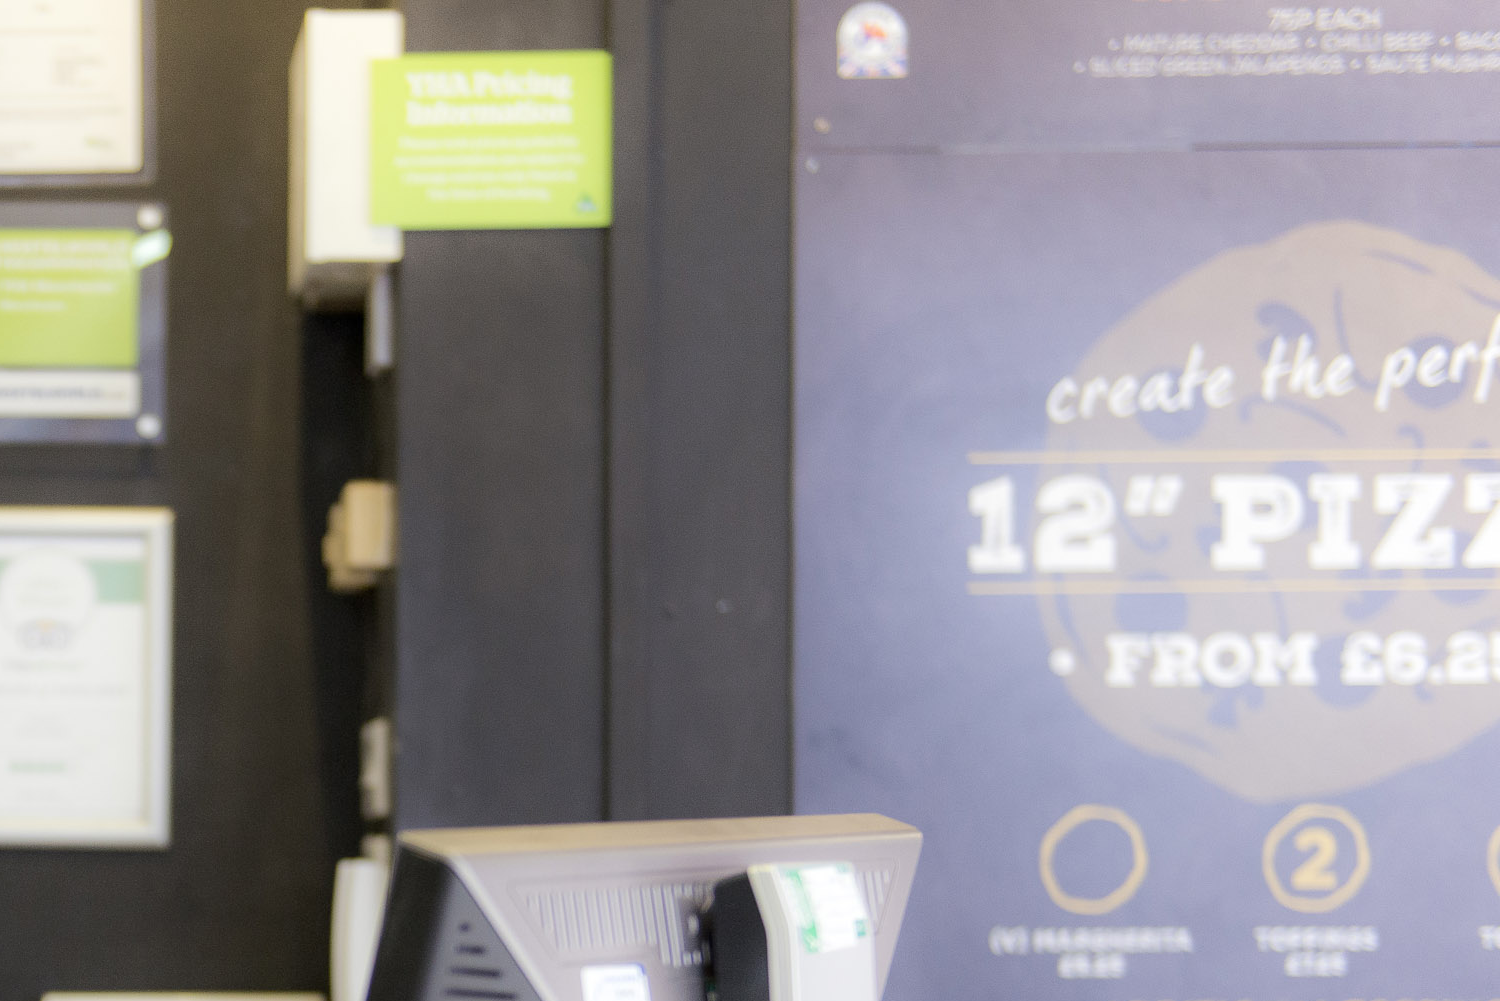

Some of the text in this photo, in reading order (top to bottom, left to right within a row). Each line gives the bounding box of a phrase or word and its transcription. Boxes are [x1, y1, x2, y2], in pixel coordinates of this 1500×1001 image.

[1315, 7, 1381, 31] EACH
[406, 69, 573, 101] YHA Pricing
[406, 99, 573, 126] Information
[1046, 342, 1236, 425] create
[1262, 333, 1358, 401] the
[1105, 630, 1500, 688] FROM £6.2
[1290, 826, 1339, 891] 2
